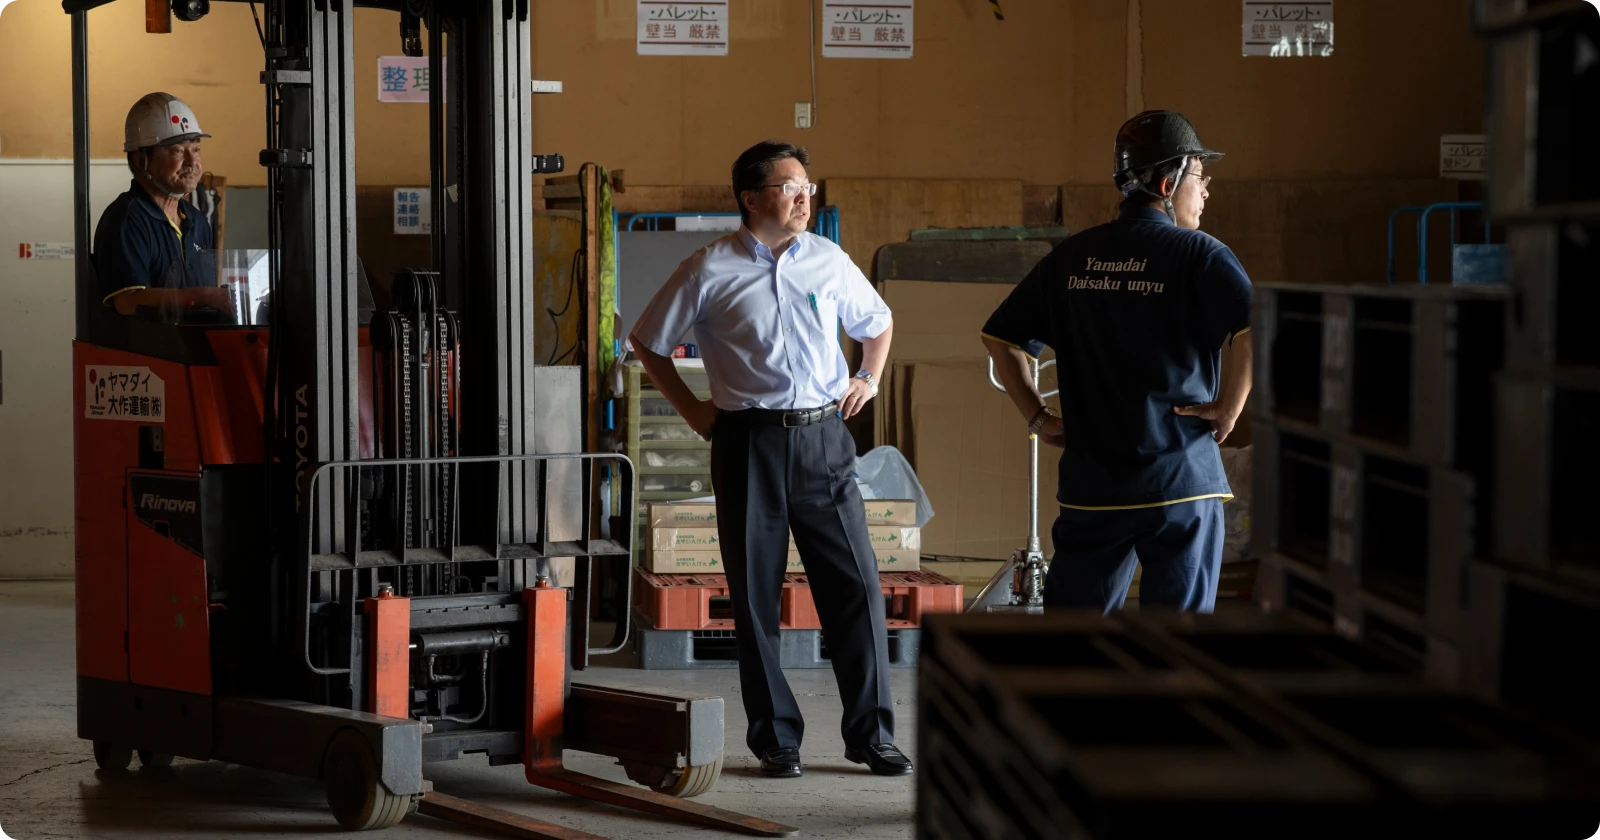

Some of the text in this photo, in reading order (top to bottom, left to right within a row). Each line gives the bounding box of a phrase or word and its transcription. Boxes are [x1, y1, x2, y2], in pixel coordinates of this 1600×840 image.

[646, 23, 720, 39] 壁当 厳禁
[831, 26, 905, 42] 壁当 厳禁
[383, 66, 429, 91] 整理
[1085, 257, 1148, 272] Yamadai
[1068, 276, 1165, 296] Daisaku unyu
[108, 372, 151, 392] ヤマダイ
